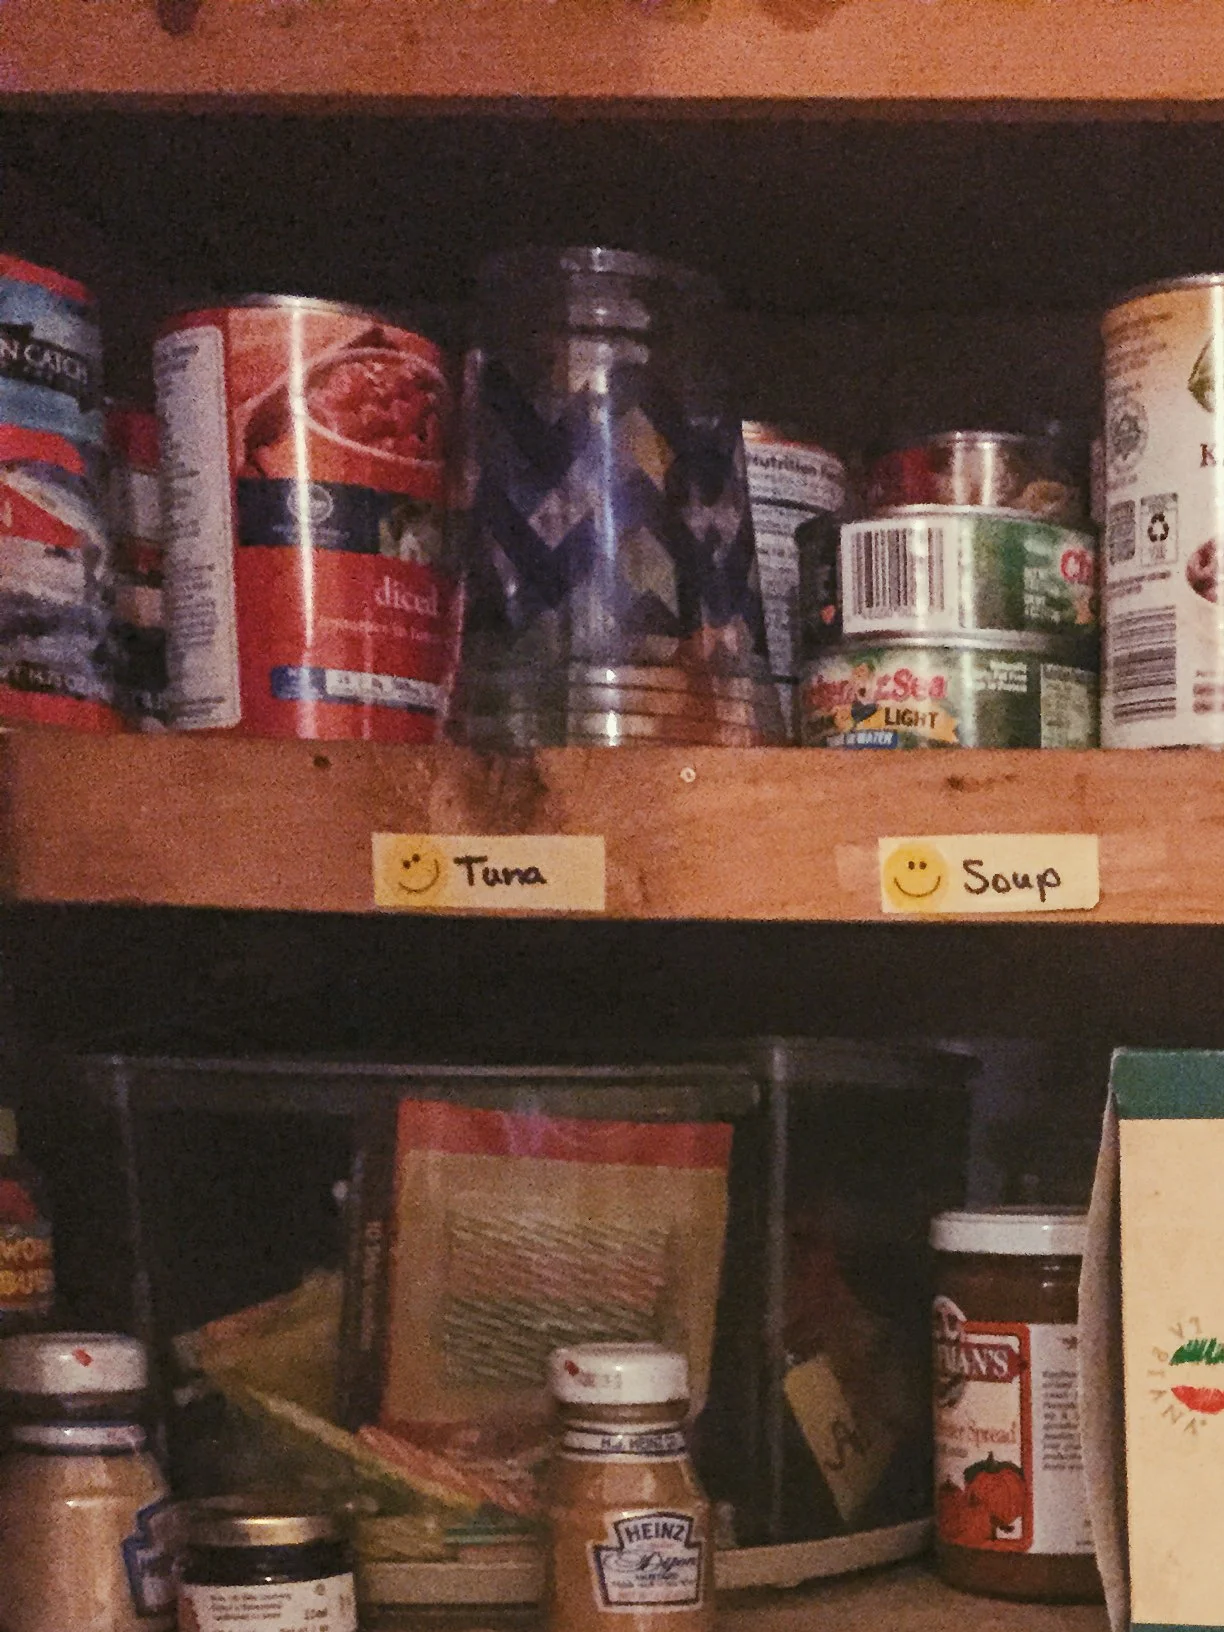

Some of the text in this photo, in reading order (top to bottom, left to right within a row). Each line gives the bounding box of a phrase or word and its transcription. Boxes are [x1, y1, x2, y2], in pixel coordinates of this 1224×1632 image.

[884, 706, 939, 730] LIGHT
[452, 855, 548, 888] Tuna
[962, 858, 1062, 904] Soup
[624, 1521, 686, 1543] HEINZ
